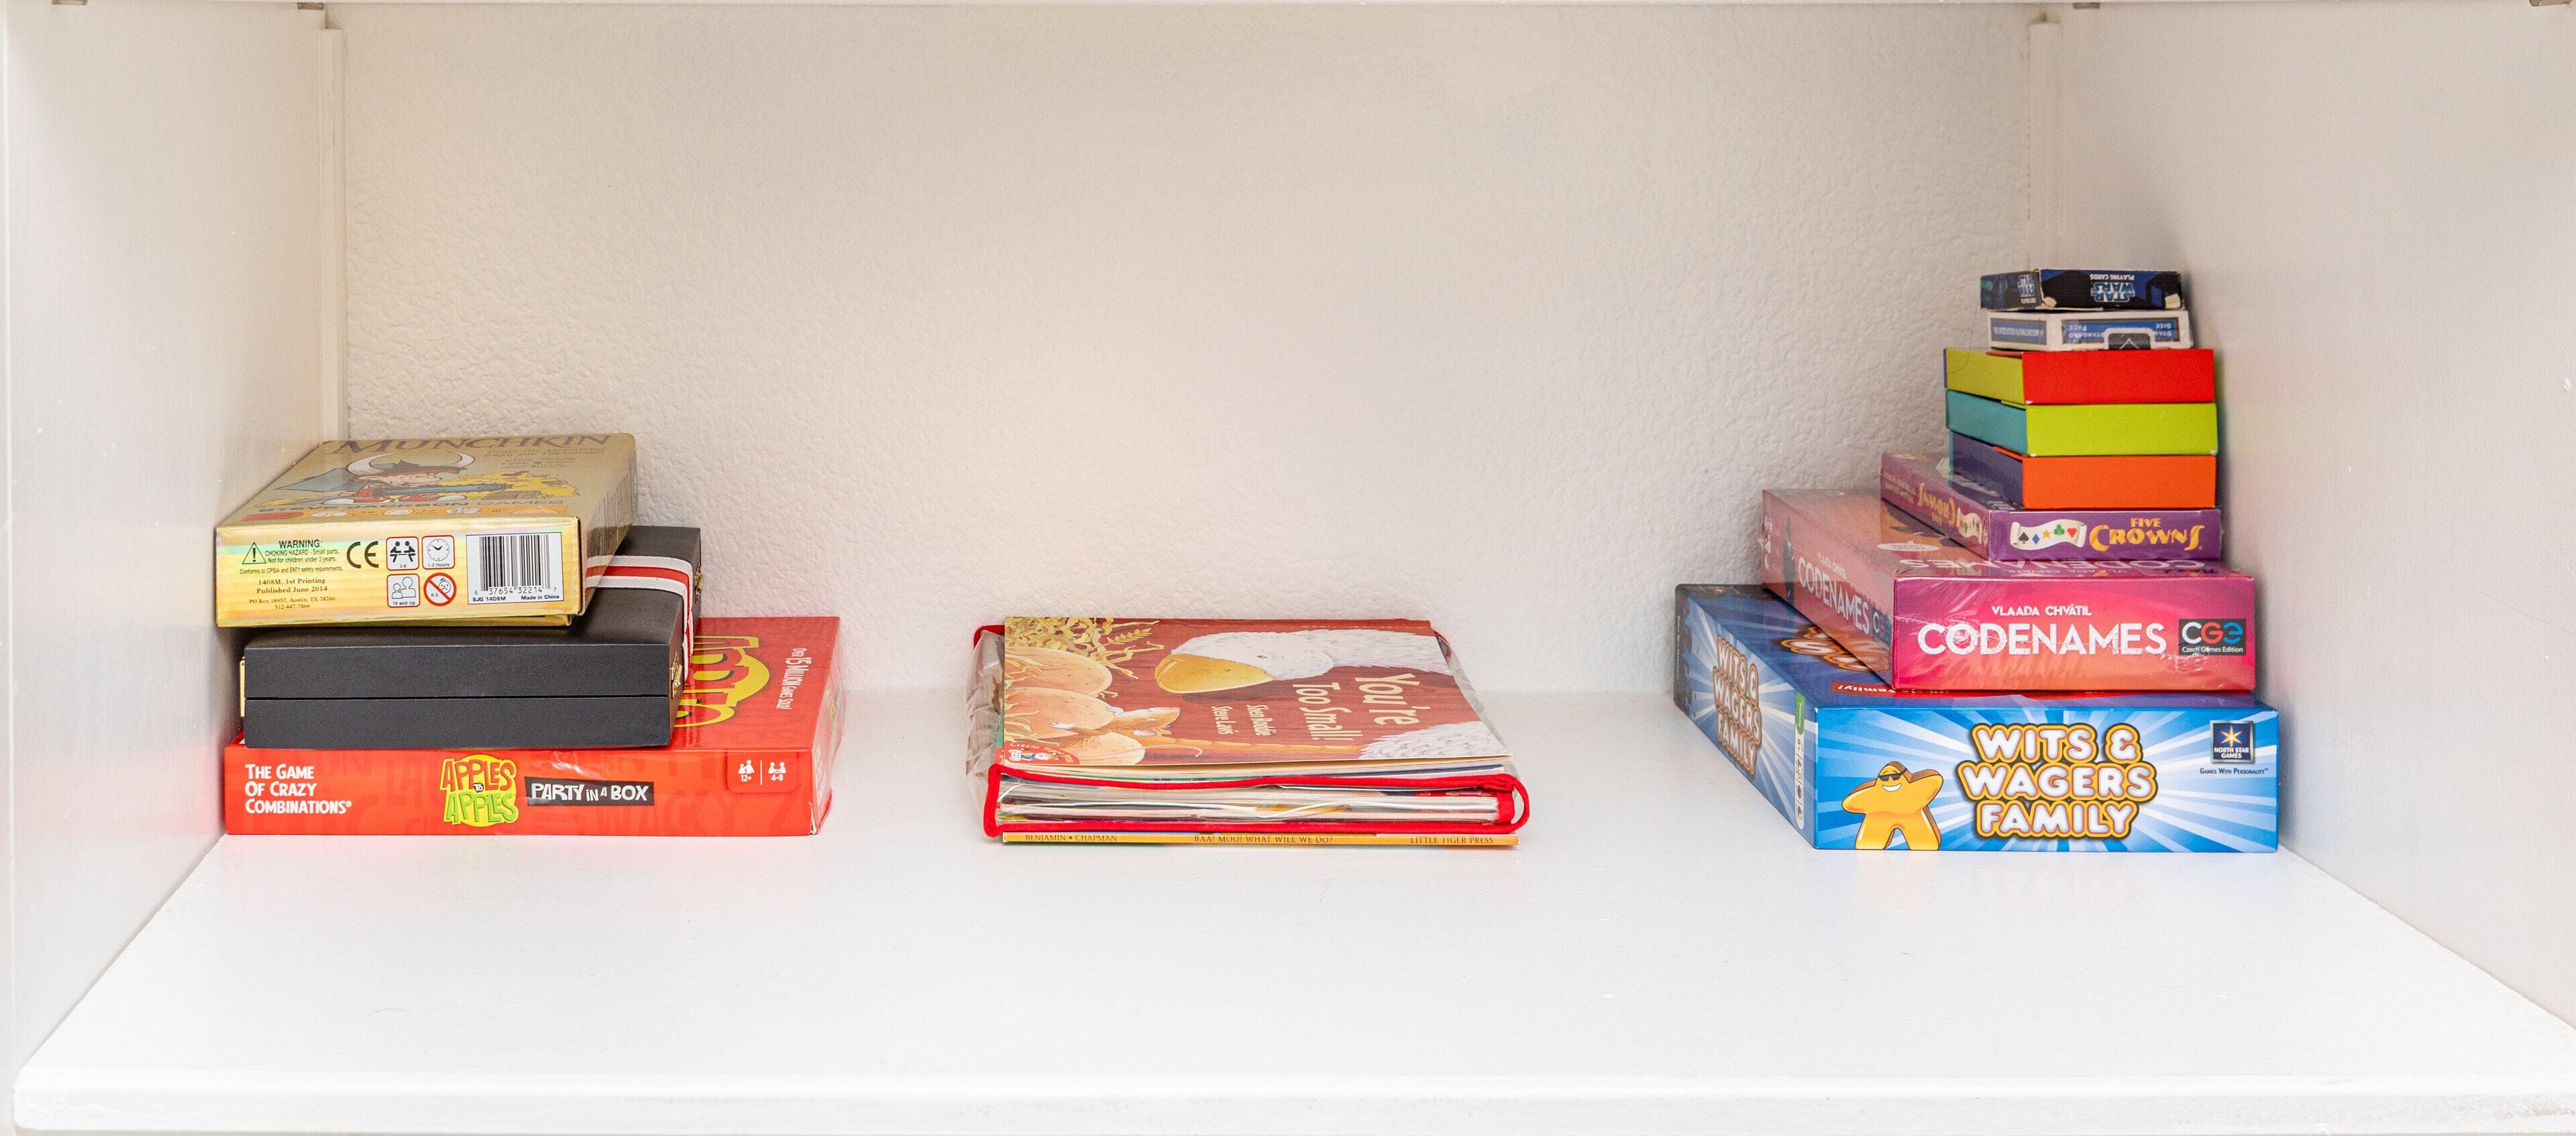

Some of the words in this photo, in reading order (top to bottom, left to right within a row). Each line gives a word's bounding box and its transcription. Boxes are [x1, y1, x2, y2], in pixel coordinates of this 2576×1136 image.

[2090, 282, 2135, 293] WARS
[2094, 292, 2131, 302] STAR
[331, 435, 614, 454] MUNCHKIN
[1917, 482, 1955, 526] CROWNS
[2131, 518, 2161, 527] FIVE
[278, 539, 323, 548] WARNING:
[2089, 525, 2205, 552] CROWNS
[347, 541, 379, 568] CE
[1899, 558, 2205, 569] CODENAMES
[297, 577, 326, 585] Printing
[488, 587, 513, 595] 37654
[1798, 556, 1870, 634] CODENAMES
[1991, 605, 2039, 616] VLAADA
[2045, 604, 2092, 616] CHVÁTIL
[1917, 622, 2167, 654] CODENAMES
[785, 657, 812, 665] 15
[792, 648, 808, 658] OVER
[781, 664, 810, 686] MILLION
[1717, 636, 1747, 691] WITS
[1750, 665, 1759, 703] &
[780, 686, 798, 699] GAMES
[1292, 682, 1342, 705] Too
[1354, 672, 1432, 725] You're
[775, 699, 793, 710] SOLD!
[1211, 706, 1233, 721] Steve
[1246, 704, 1270, 717] Shen
[1713, 669, 1762, 743] WAGERS
[1250, 717, 1278, 737] Roddie
[1298, 707, 1364, 741] Small!
[1717, 709, 1757, 774] FAMILY
[1975, 727, 2096, 761] WITS
[2108, 728, 2138, 761] &
[245, 764, 272, 780] THE
[276, 763, 315, 780] GAME
[442, 759, 517, 792] APPLES
[740, 774, 753, 782] 12+
[771, 774, 784, 782] 4-8
[1960, 764, 2154, 798] WAGERS
[245, 782, 265, 797] OF
[269, 781, 318, 798] CRAZY
[531, 783, 586, 802] PARTY
[600, 786, 608, 798] A
[610, 784, 650, 802] BOX
[446, 792, 519, 823] APPLES
[1979, 803, 2134, 834] FAMILY
